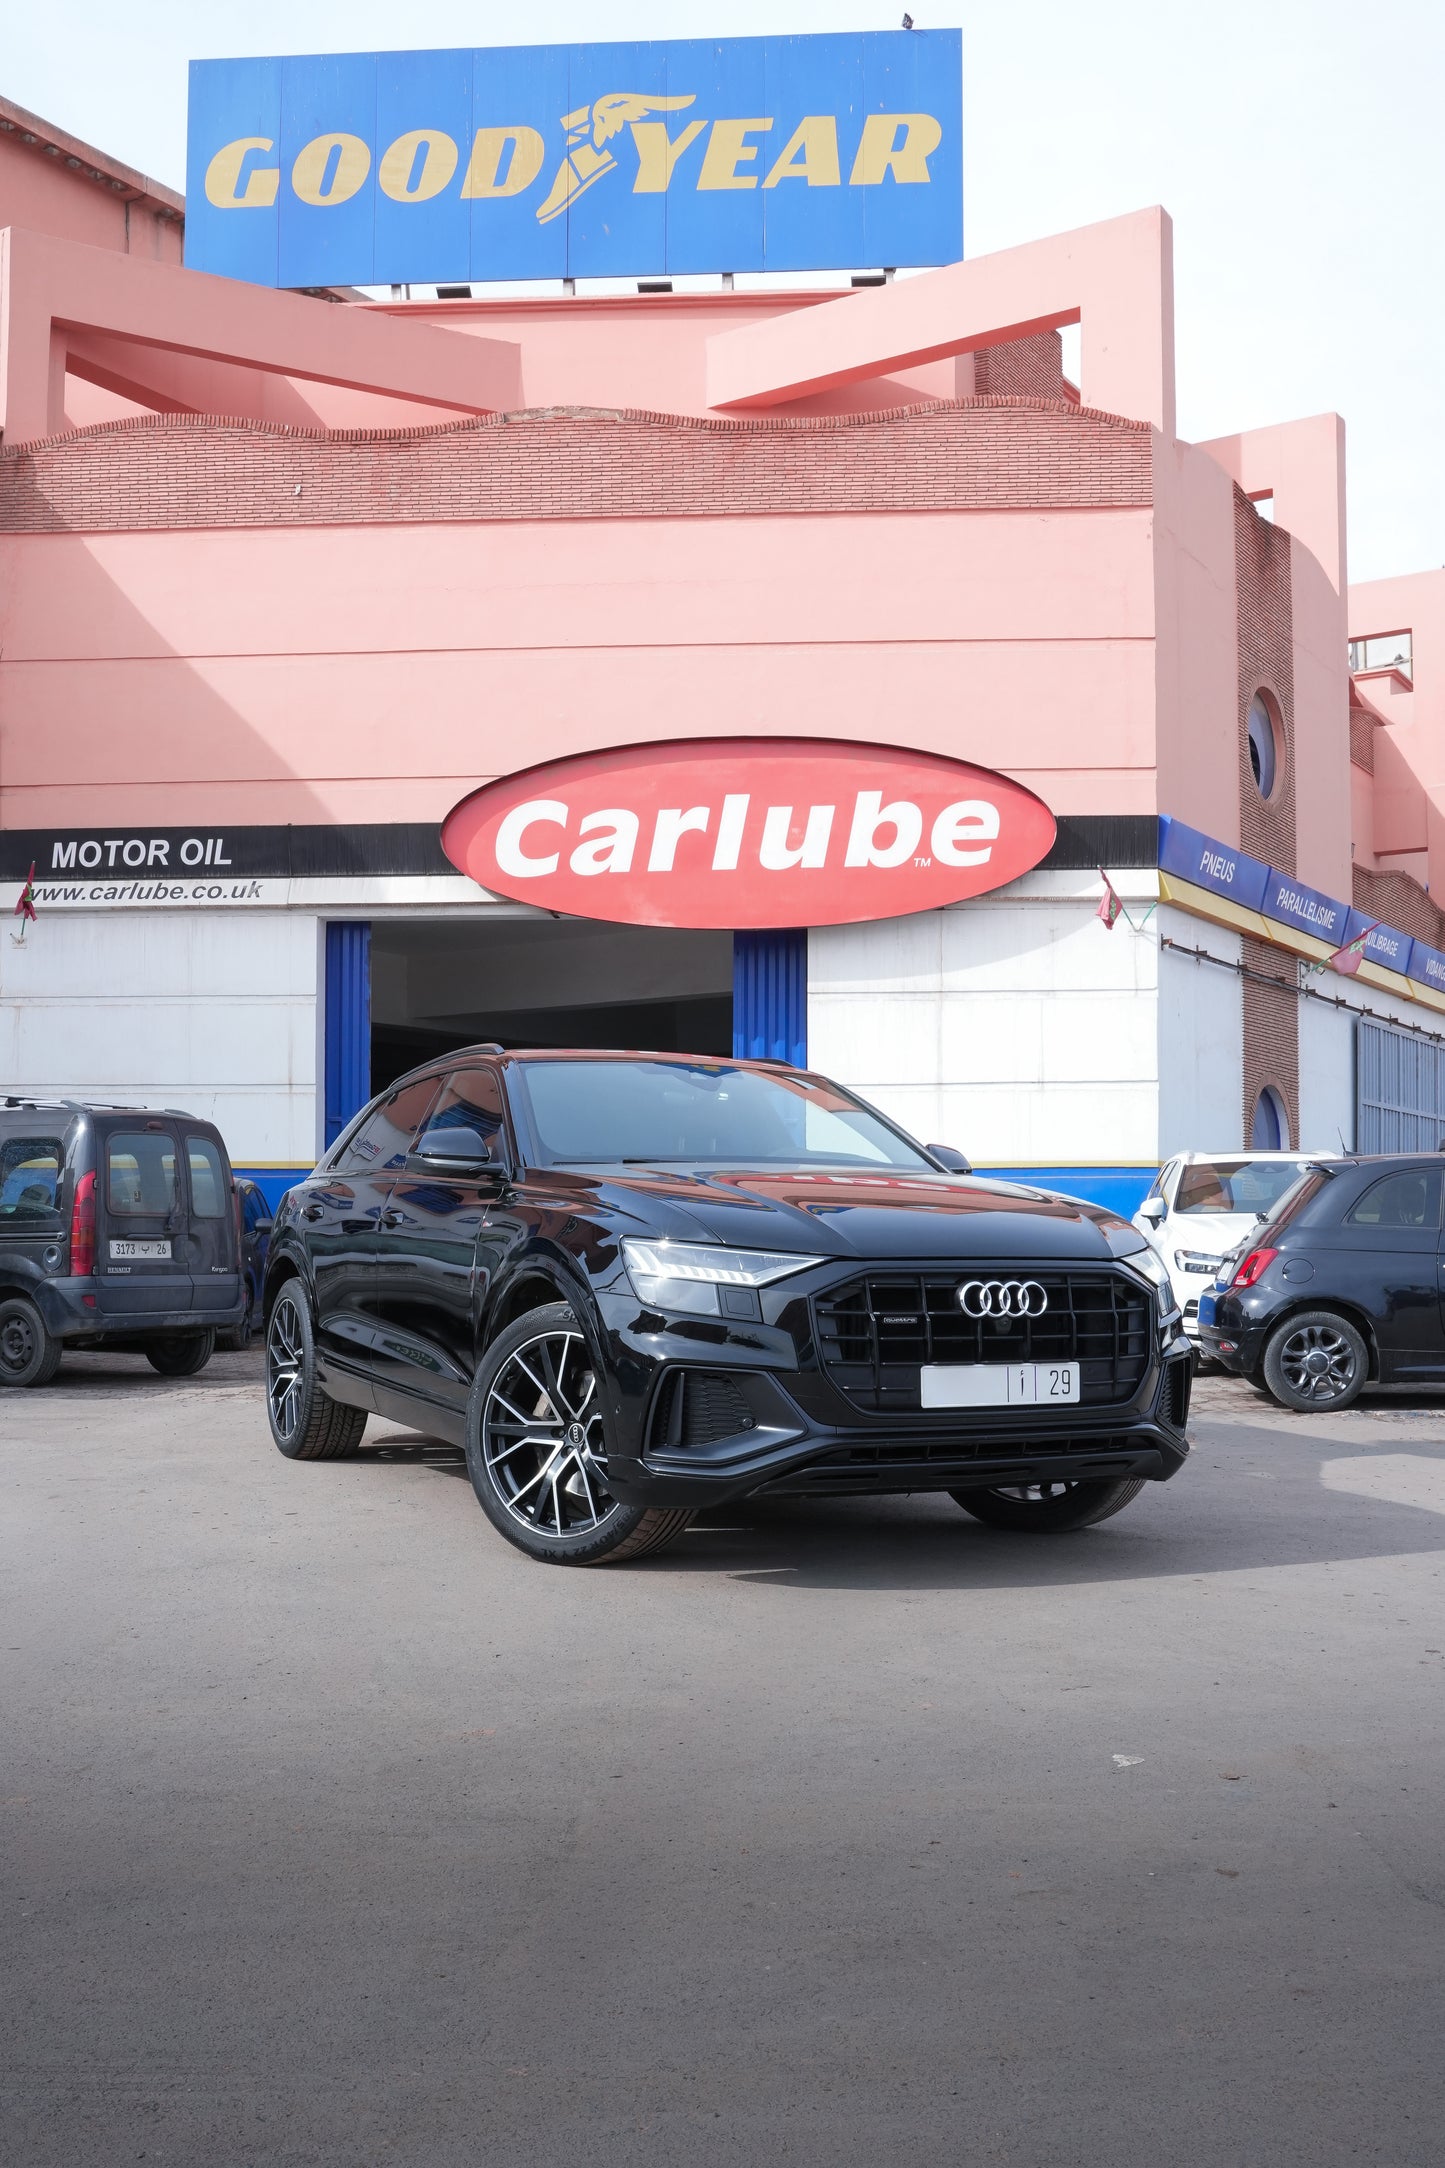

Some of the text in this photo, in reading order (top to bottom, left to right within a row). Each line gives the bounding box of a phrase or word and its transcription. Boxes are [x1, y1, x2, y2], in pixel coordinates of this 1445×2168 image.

[494, 790, 1000, 878] Carlube
[51, 838, 233, 868] MOTOR OIL
[1200, 850, 1236, 883] PNEUS
[1276, 887, 1337, 930] PARALLELISME
[1361, 928, 1399, 957] UILIBRAGE
[116, 1243, 136, 1255] 3173
[157, 1243, 167, 1255] 26
[1050, 1369, 1071, 1395] 29
